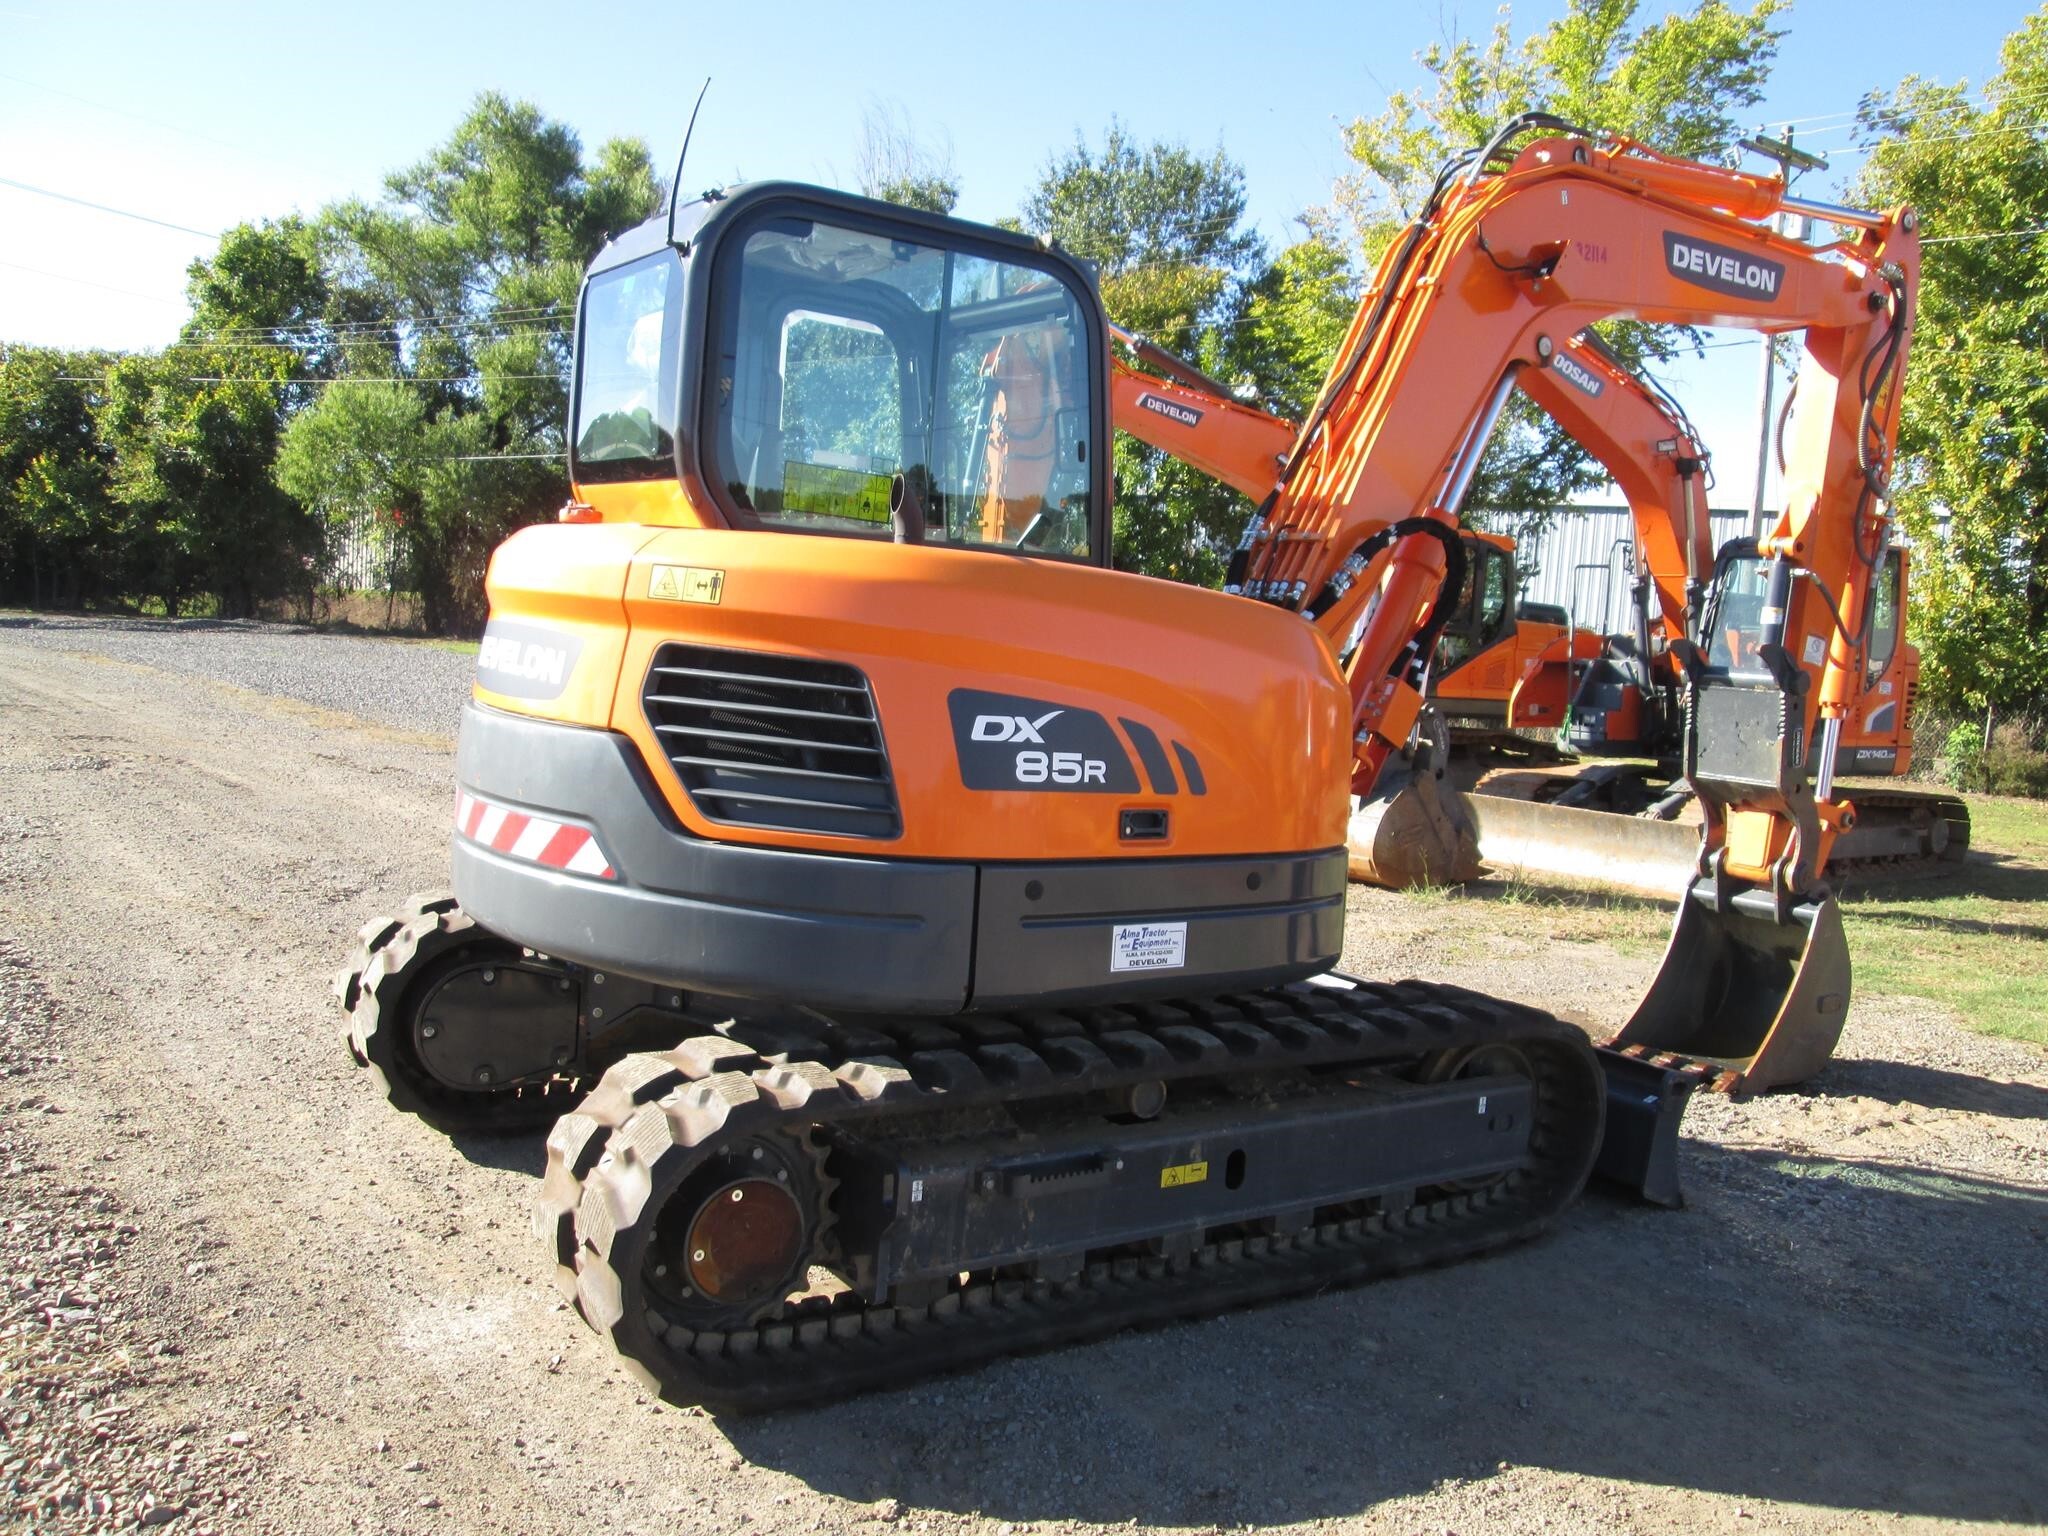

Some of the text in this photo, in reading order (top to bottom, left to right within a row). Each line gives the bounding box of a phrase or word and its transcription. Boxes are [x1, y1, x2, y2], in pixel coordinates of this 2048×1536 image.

[1673, 243, 1776, 293] DEVELON
[1147, 398, 1197, 425] DEVELON
[478, 635, 567, 684] EVELON
[970, 710, 1065, 744] DX
[1015, 750, 1107, 784] 85R
[1120, 927, 1168, 940] Alma Tractor
[1132, 938, 1171, 950] Equipment
[1129, 958, 1168, 966] DEVELON
